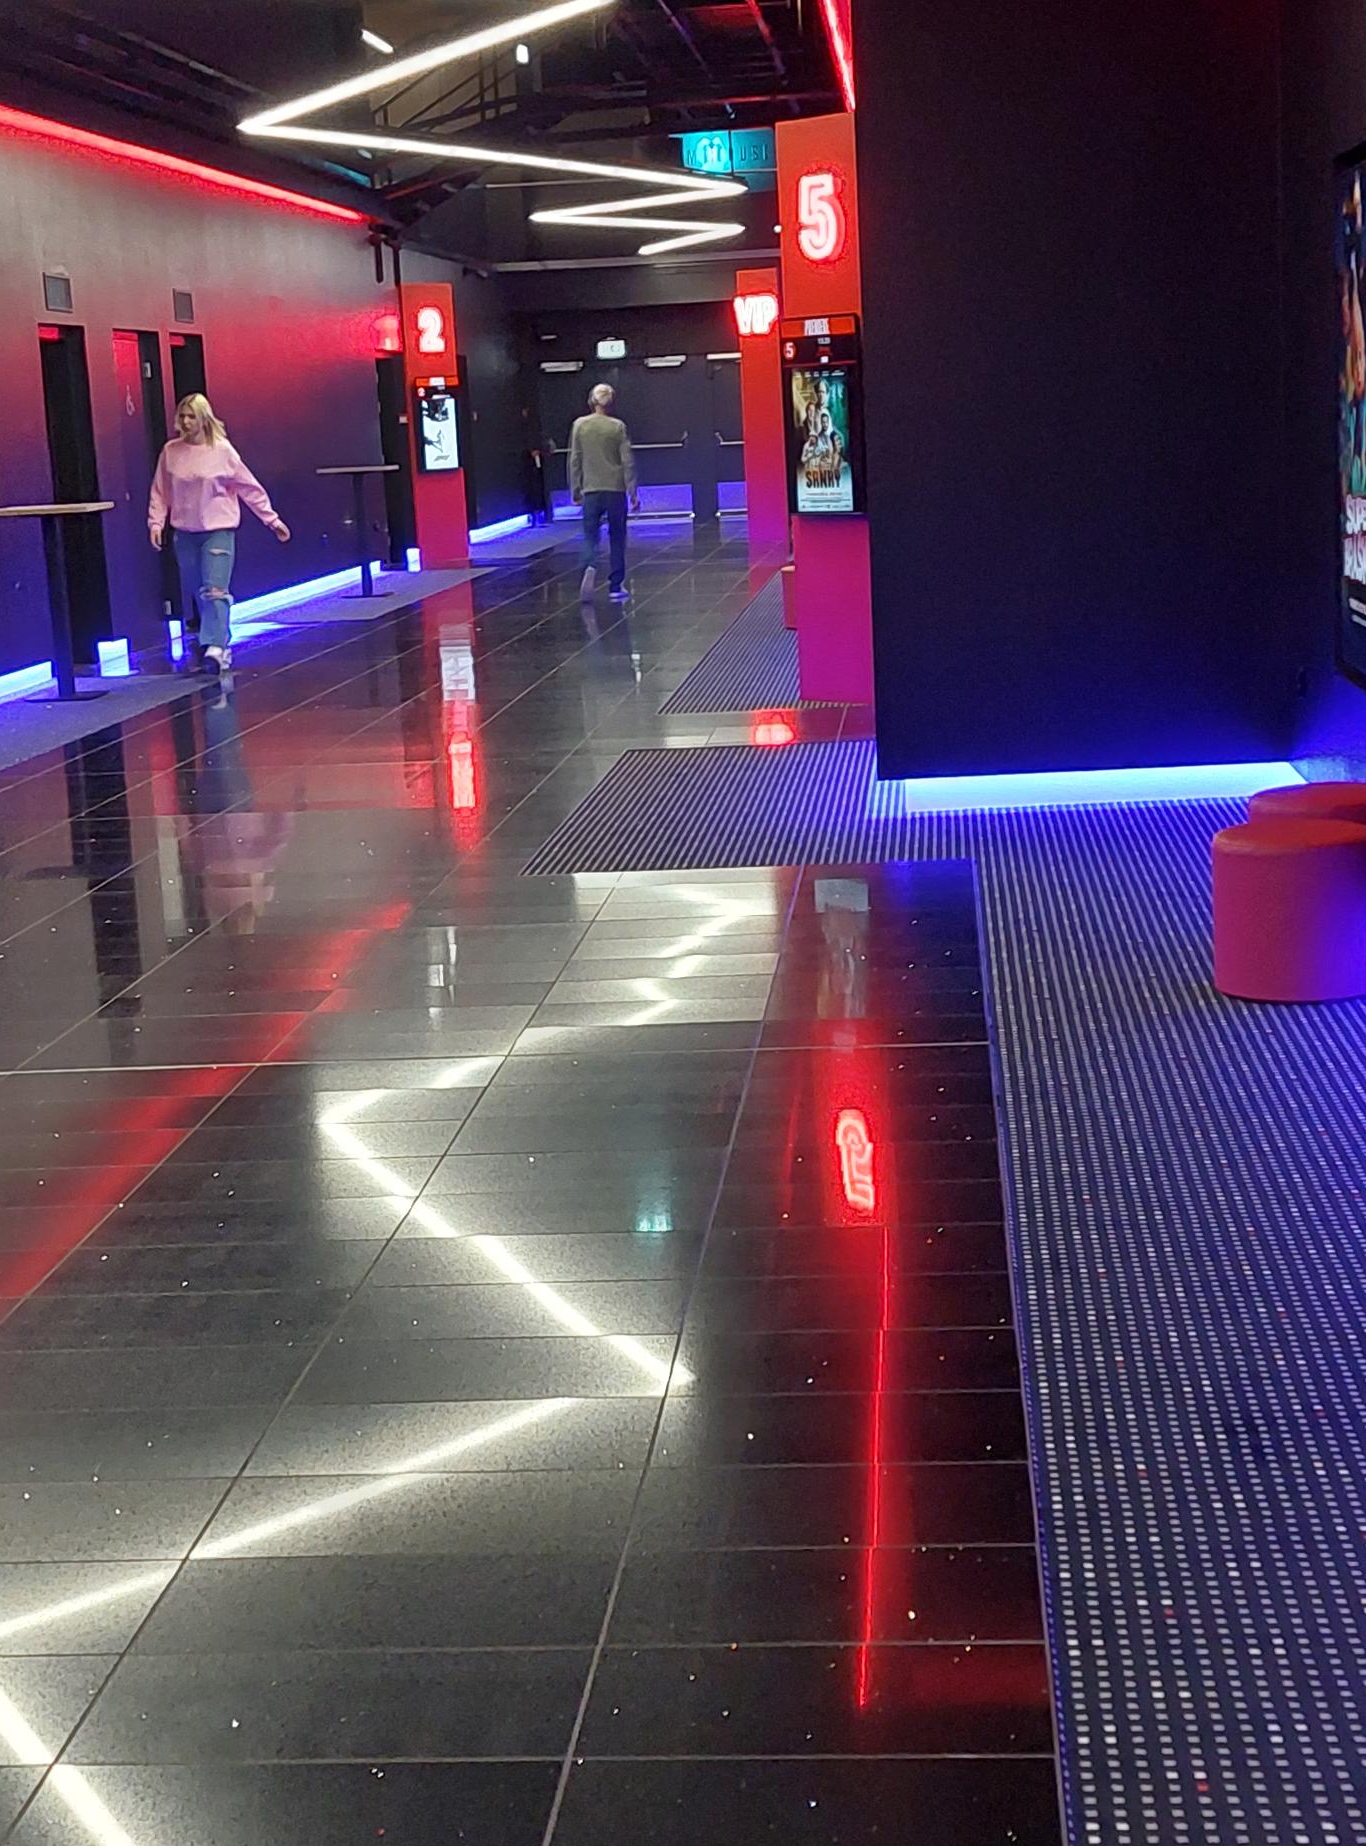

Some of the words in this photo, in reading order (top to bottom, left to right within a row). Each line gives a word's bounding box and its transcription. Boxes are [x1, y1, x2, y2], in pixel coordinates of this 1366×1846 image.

[798, 172, 842, 262] 5
[417, 307, 446, 353] 2
[734, 295, 779, 335] VIP
[785, 342, 795, 359] 5
